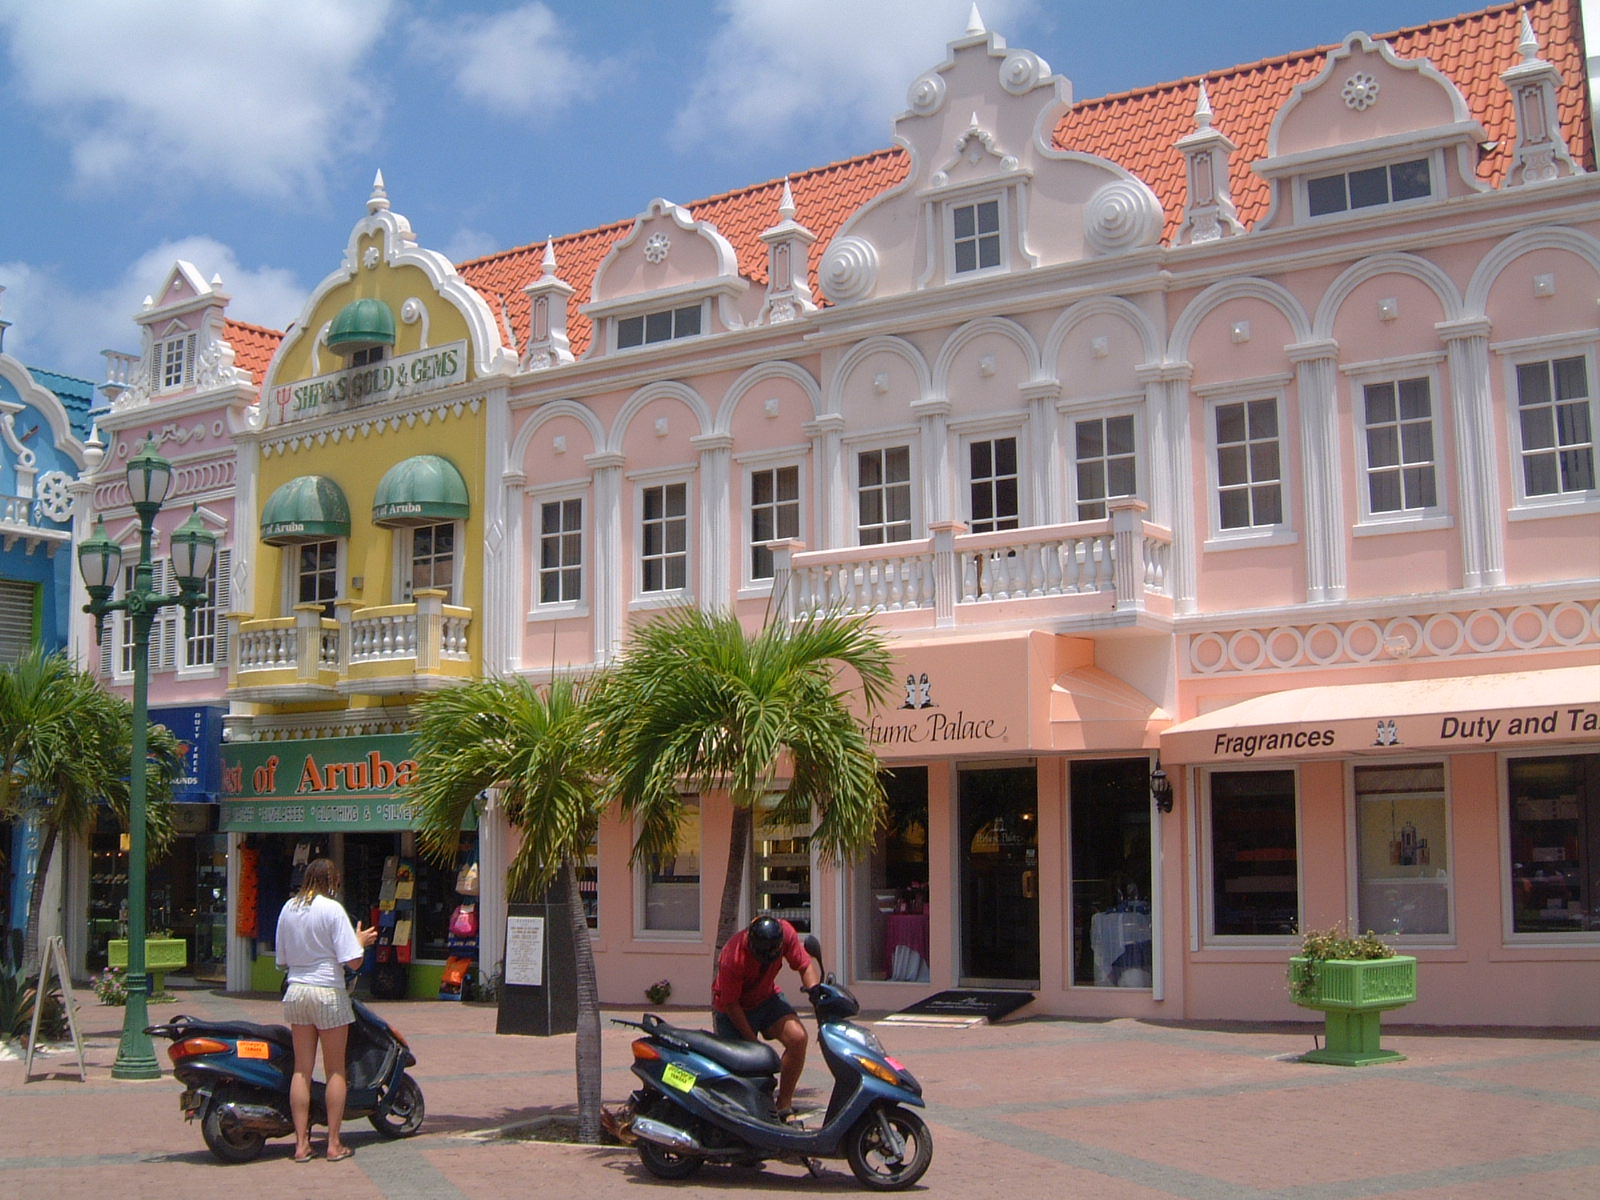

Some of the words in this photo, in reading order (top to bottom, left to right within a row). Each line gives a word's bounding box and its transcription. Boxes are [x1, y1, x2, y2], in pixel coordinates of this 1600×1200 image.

[351, 366, 395, 398] GOLD
[396, 362, 409, 386] &
[411, 350, 458, 383] GEMS
[390, 502, 422, 514] Aruba
[275, 522, 304, 534] Aruba
[860, 713, 930, 746] rfume
[926, 711, 1007, 742] Palace
[1441, 716, 1501, 743] Duty
[1508, 710, 1558, 736] and
[1567, 709, 1600, 732] Ta
[1214, 729, 1335, 757] Fragrances
[253, 754, 280, 795] of
[295, 750, 420, 795] Aruba
[364, 805, 372, 822] &
